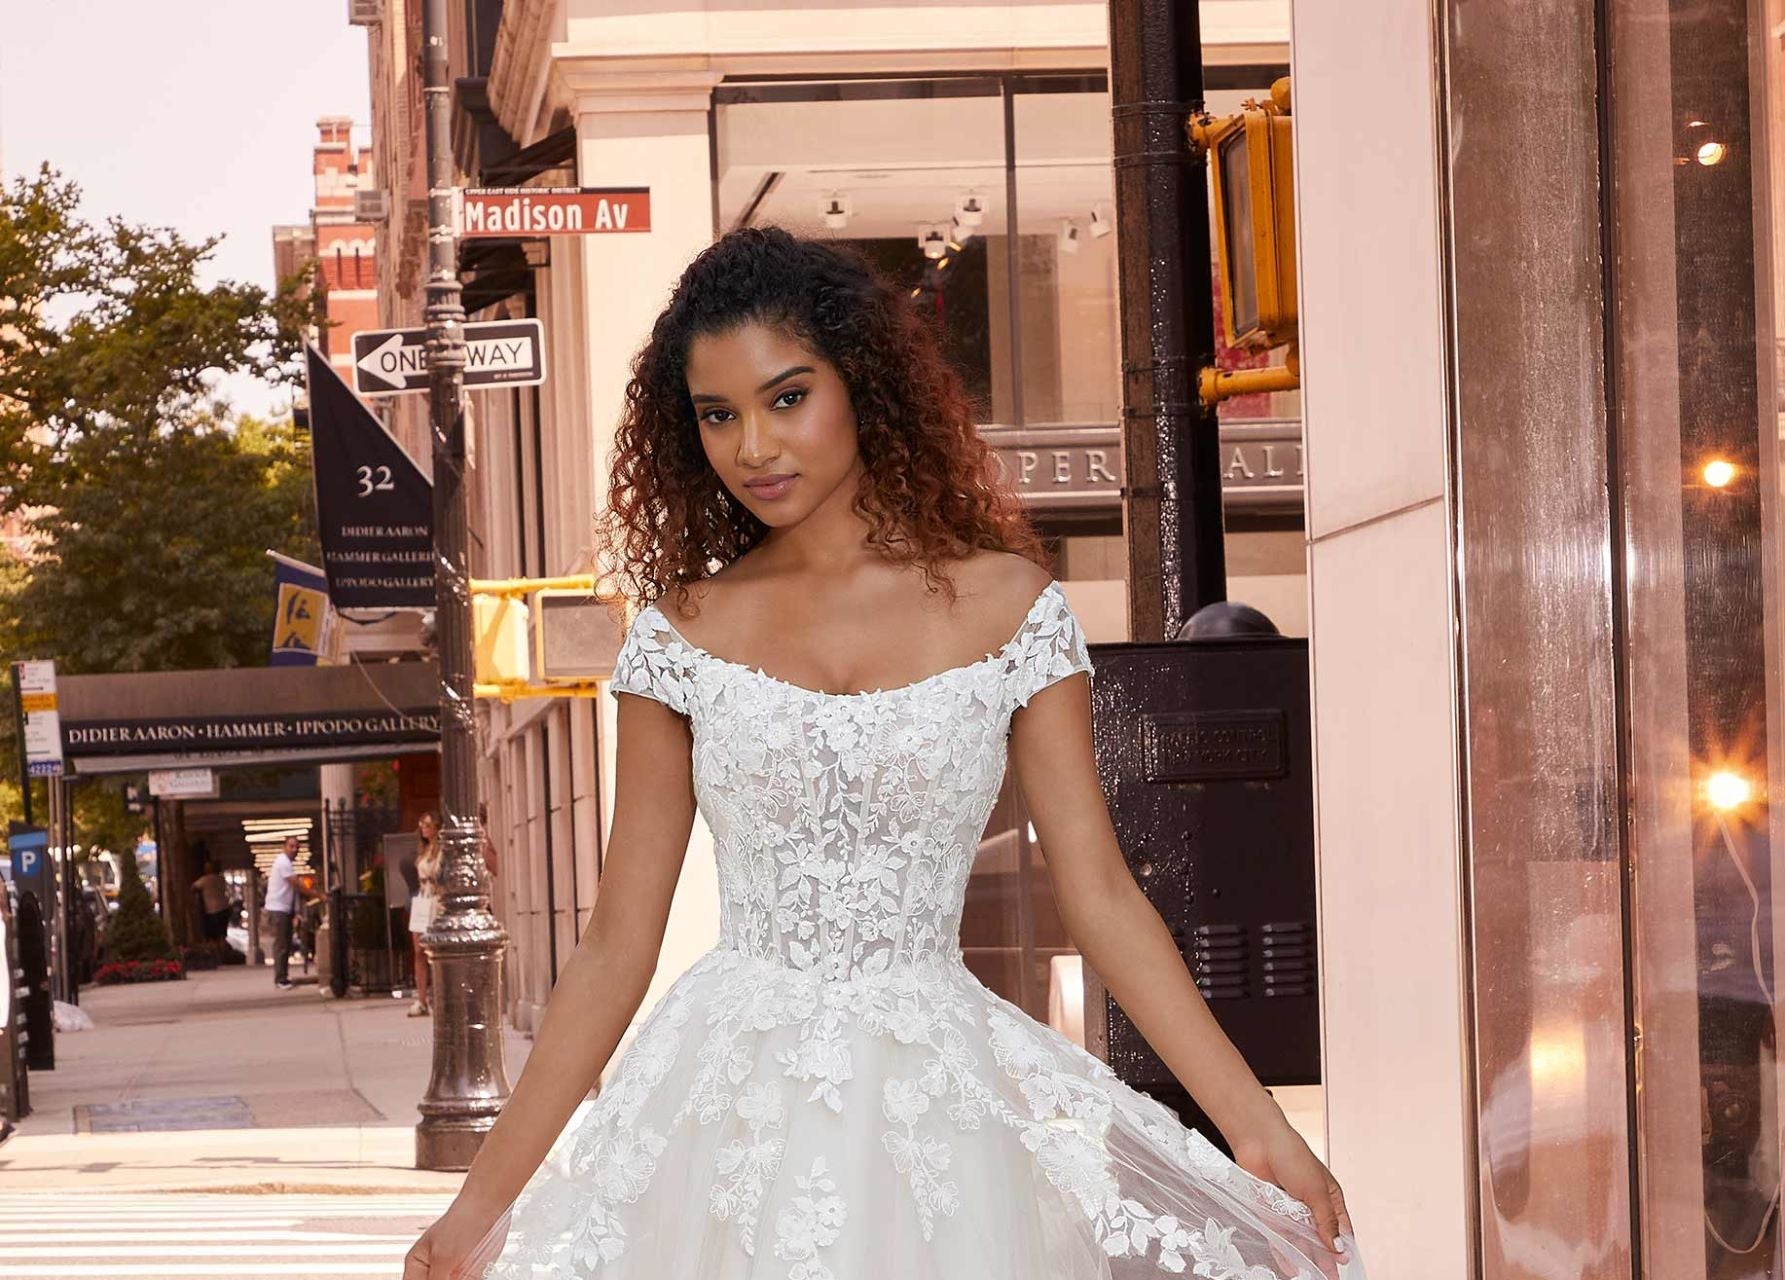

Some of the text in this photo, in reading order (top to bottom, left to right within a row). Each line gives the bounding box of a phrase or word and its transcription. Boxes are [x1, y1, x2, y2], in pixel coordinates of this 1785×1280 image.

[465, 197, 628, 232] Madison Av
[466, 341, 523, 367] WAY
[1018, 450, 1117, 485] PER
[356, 465, 395, 498] 32
[326, 551, 380, 563] HAMMER
[383, 577, 434, 588] GALLERY
[206, 721, 285, 739] HAMMER
[295, 718, 362, 735] IPPODO
[364, 714, 440, 732] GALLERY
[21, 850, 36, 873] P
